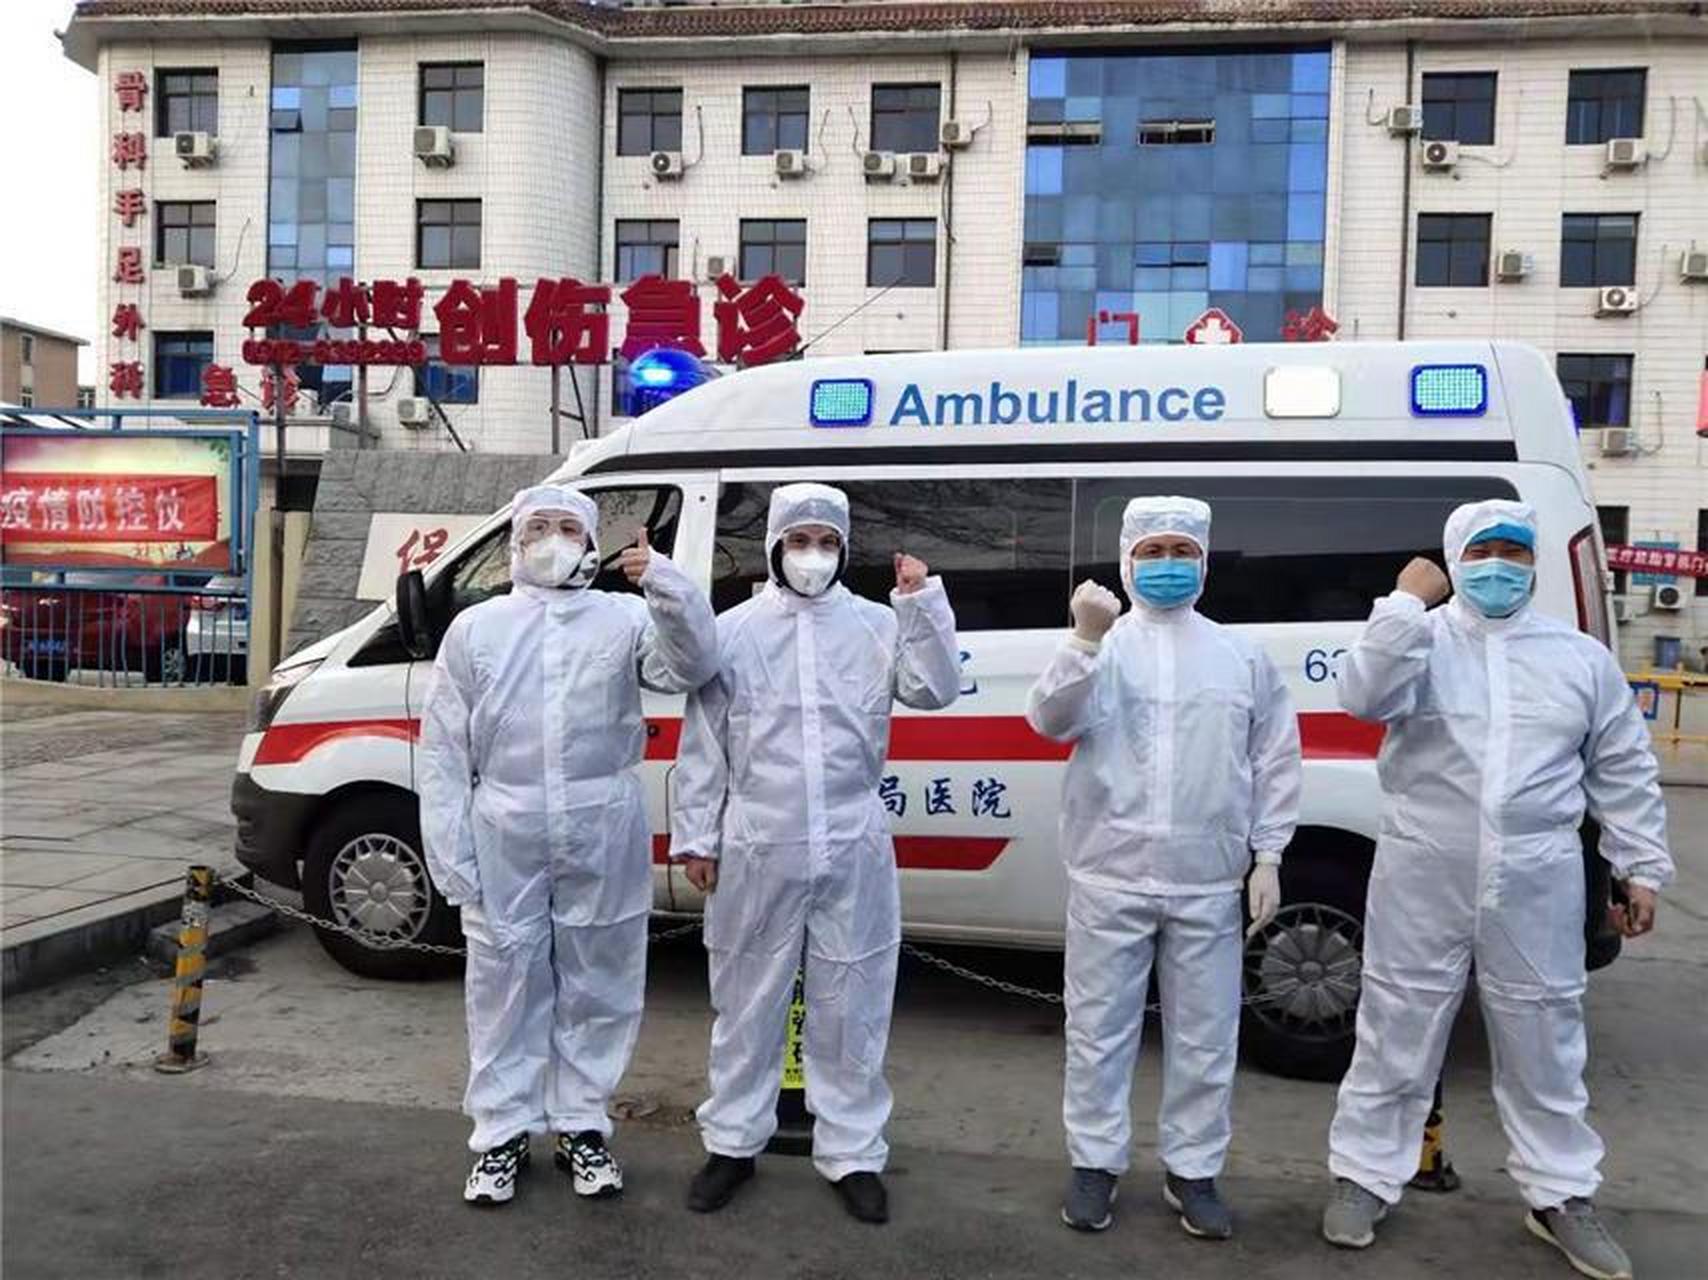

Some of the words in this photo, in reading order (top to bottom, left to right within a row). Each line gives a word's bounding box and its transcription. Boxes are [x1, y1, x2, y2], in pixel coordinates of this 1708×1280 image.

[110, 71, 148, 399] 骨科手足外科
[434, 272, 804, 364] 创伤急诊
[889, 379, 1226, 426] Ambulance
[878, 775, 1011, 818] 局医院
